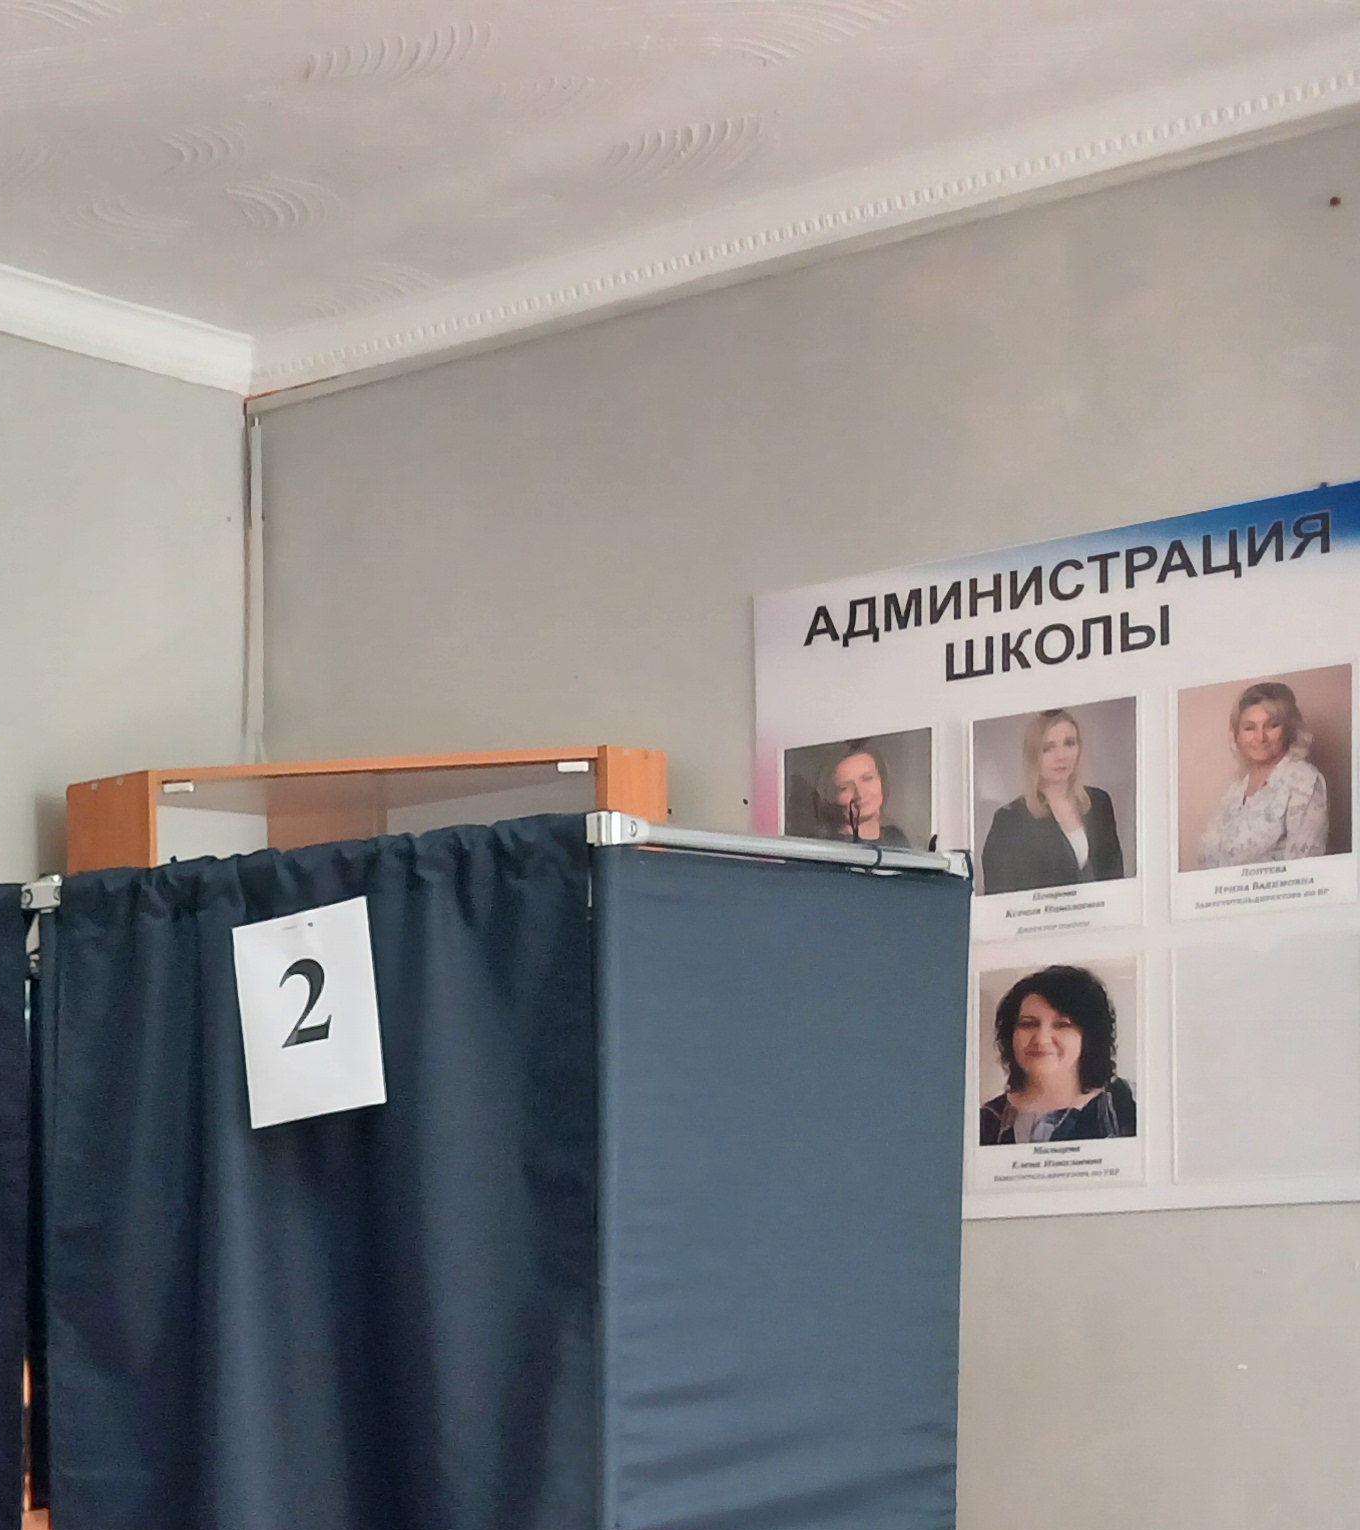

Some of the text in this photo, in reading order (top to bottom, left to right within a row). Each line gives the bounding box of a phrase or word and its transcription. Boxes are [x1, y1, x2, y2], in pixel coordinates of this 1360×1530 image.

[803, 510, 1333, 646] АДМИНИСТРАЦИЯ
[944, 605, 1171, 682] ШКОЛЫ
[279, 957, 333, 1049] 2
